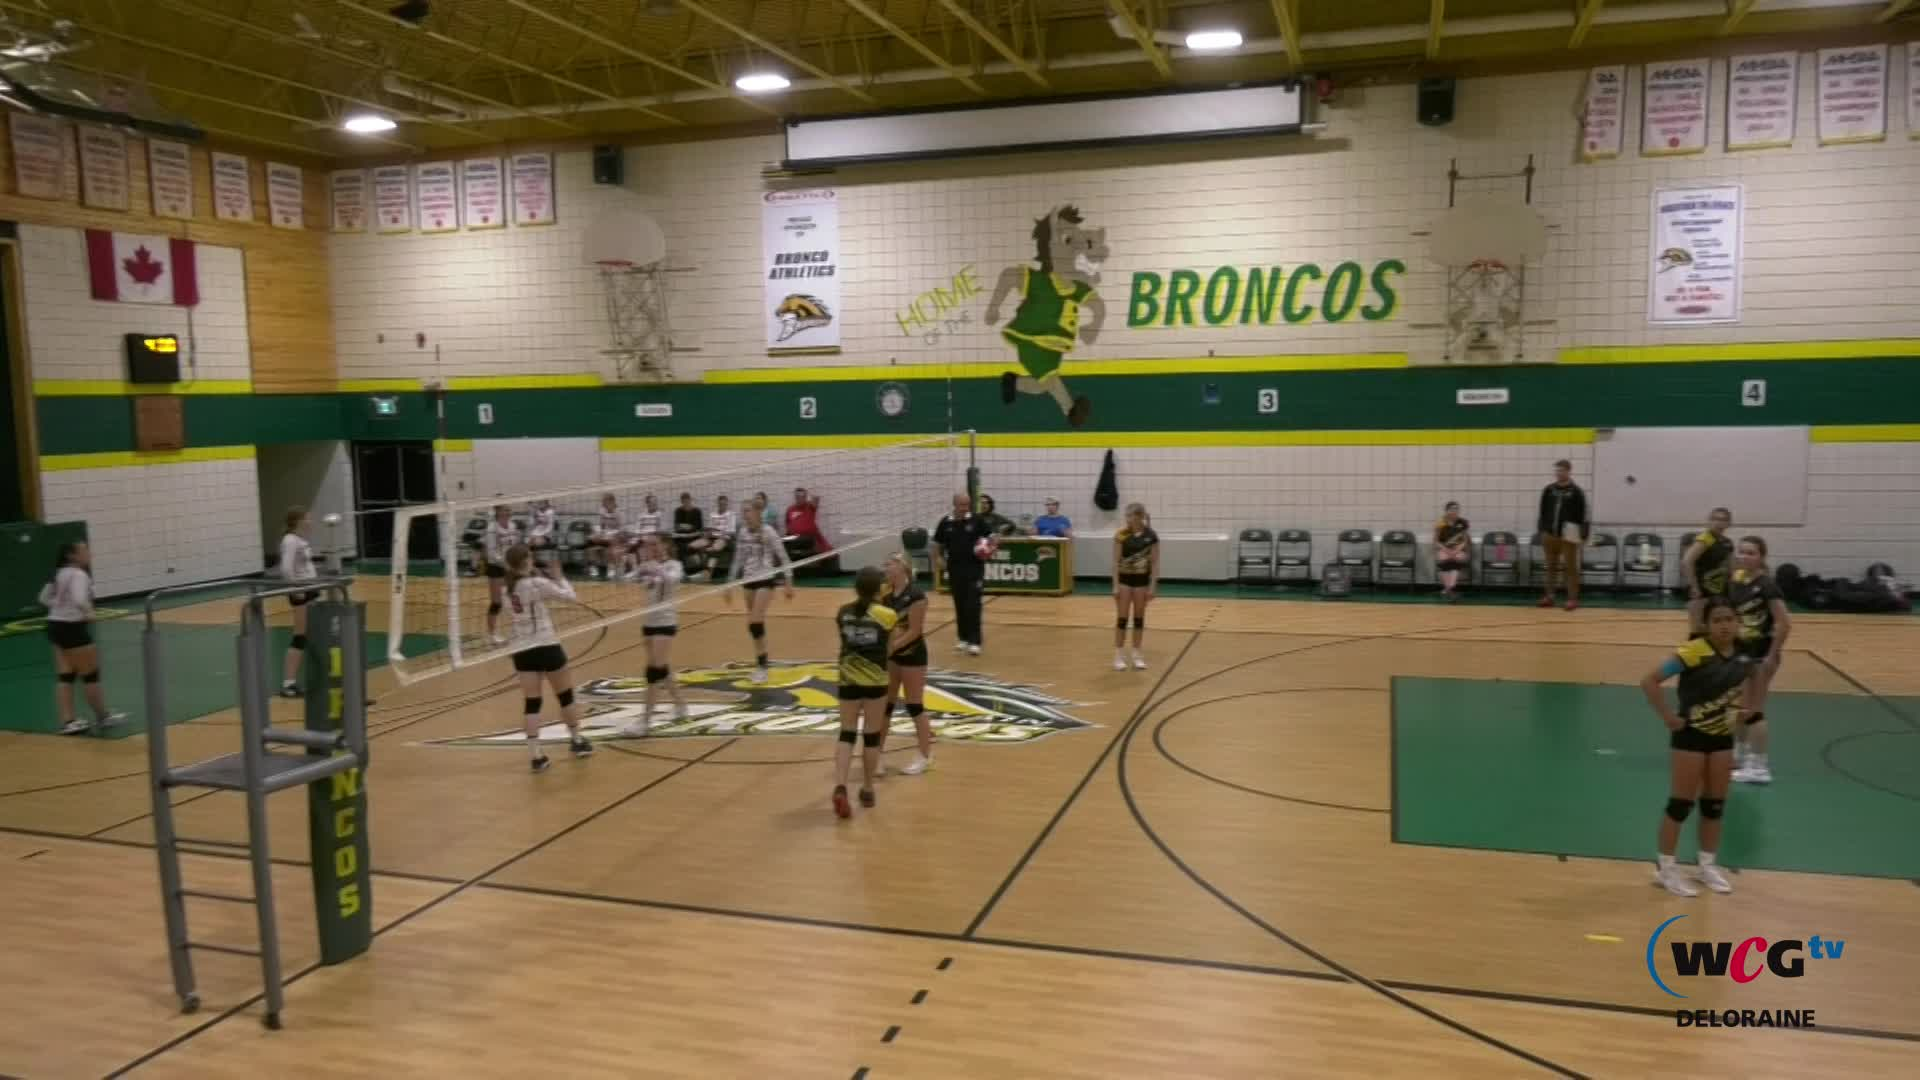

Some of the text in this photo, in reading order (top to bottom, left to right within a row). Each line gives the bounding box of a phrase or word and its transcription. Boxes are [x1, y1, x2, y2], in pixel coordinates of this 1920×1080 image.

[774, 251, 829, 265] BRONCO
[769, 265, 836, 280] ATHLETICS
[896, 264, 984, 336] HOME
[1127, 259, 1406, 328] BRONCOS
[1263, 392, 1273, 410] 3
[1745, 383, 1761, 402] 4
[803, 400, 814, 415] 2
